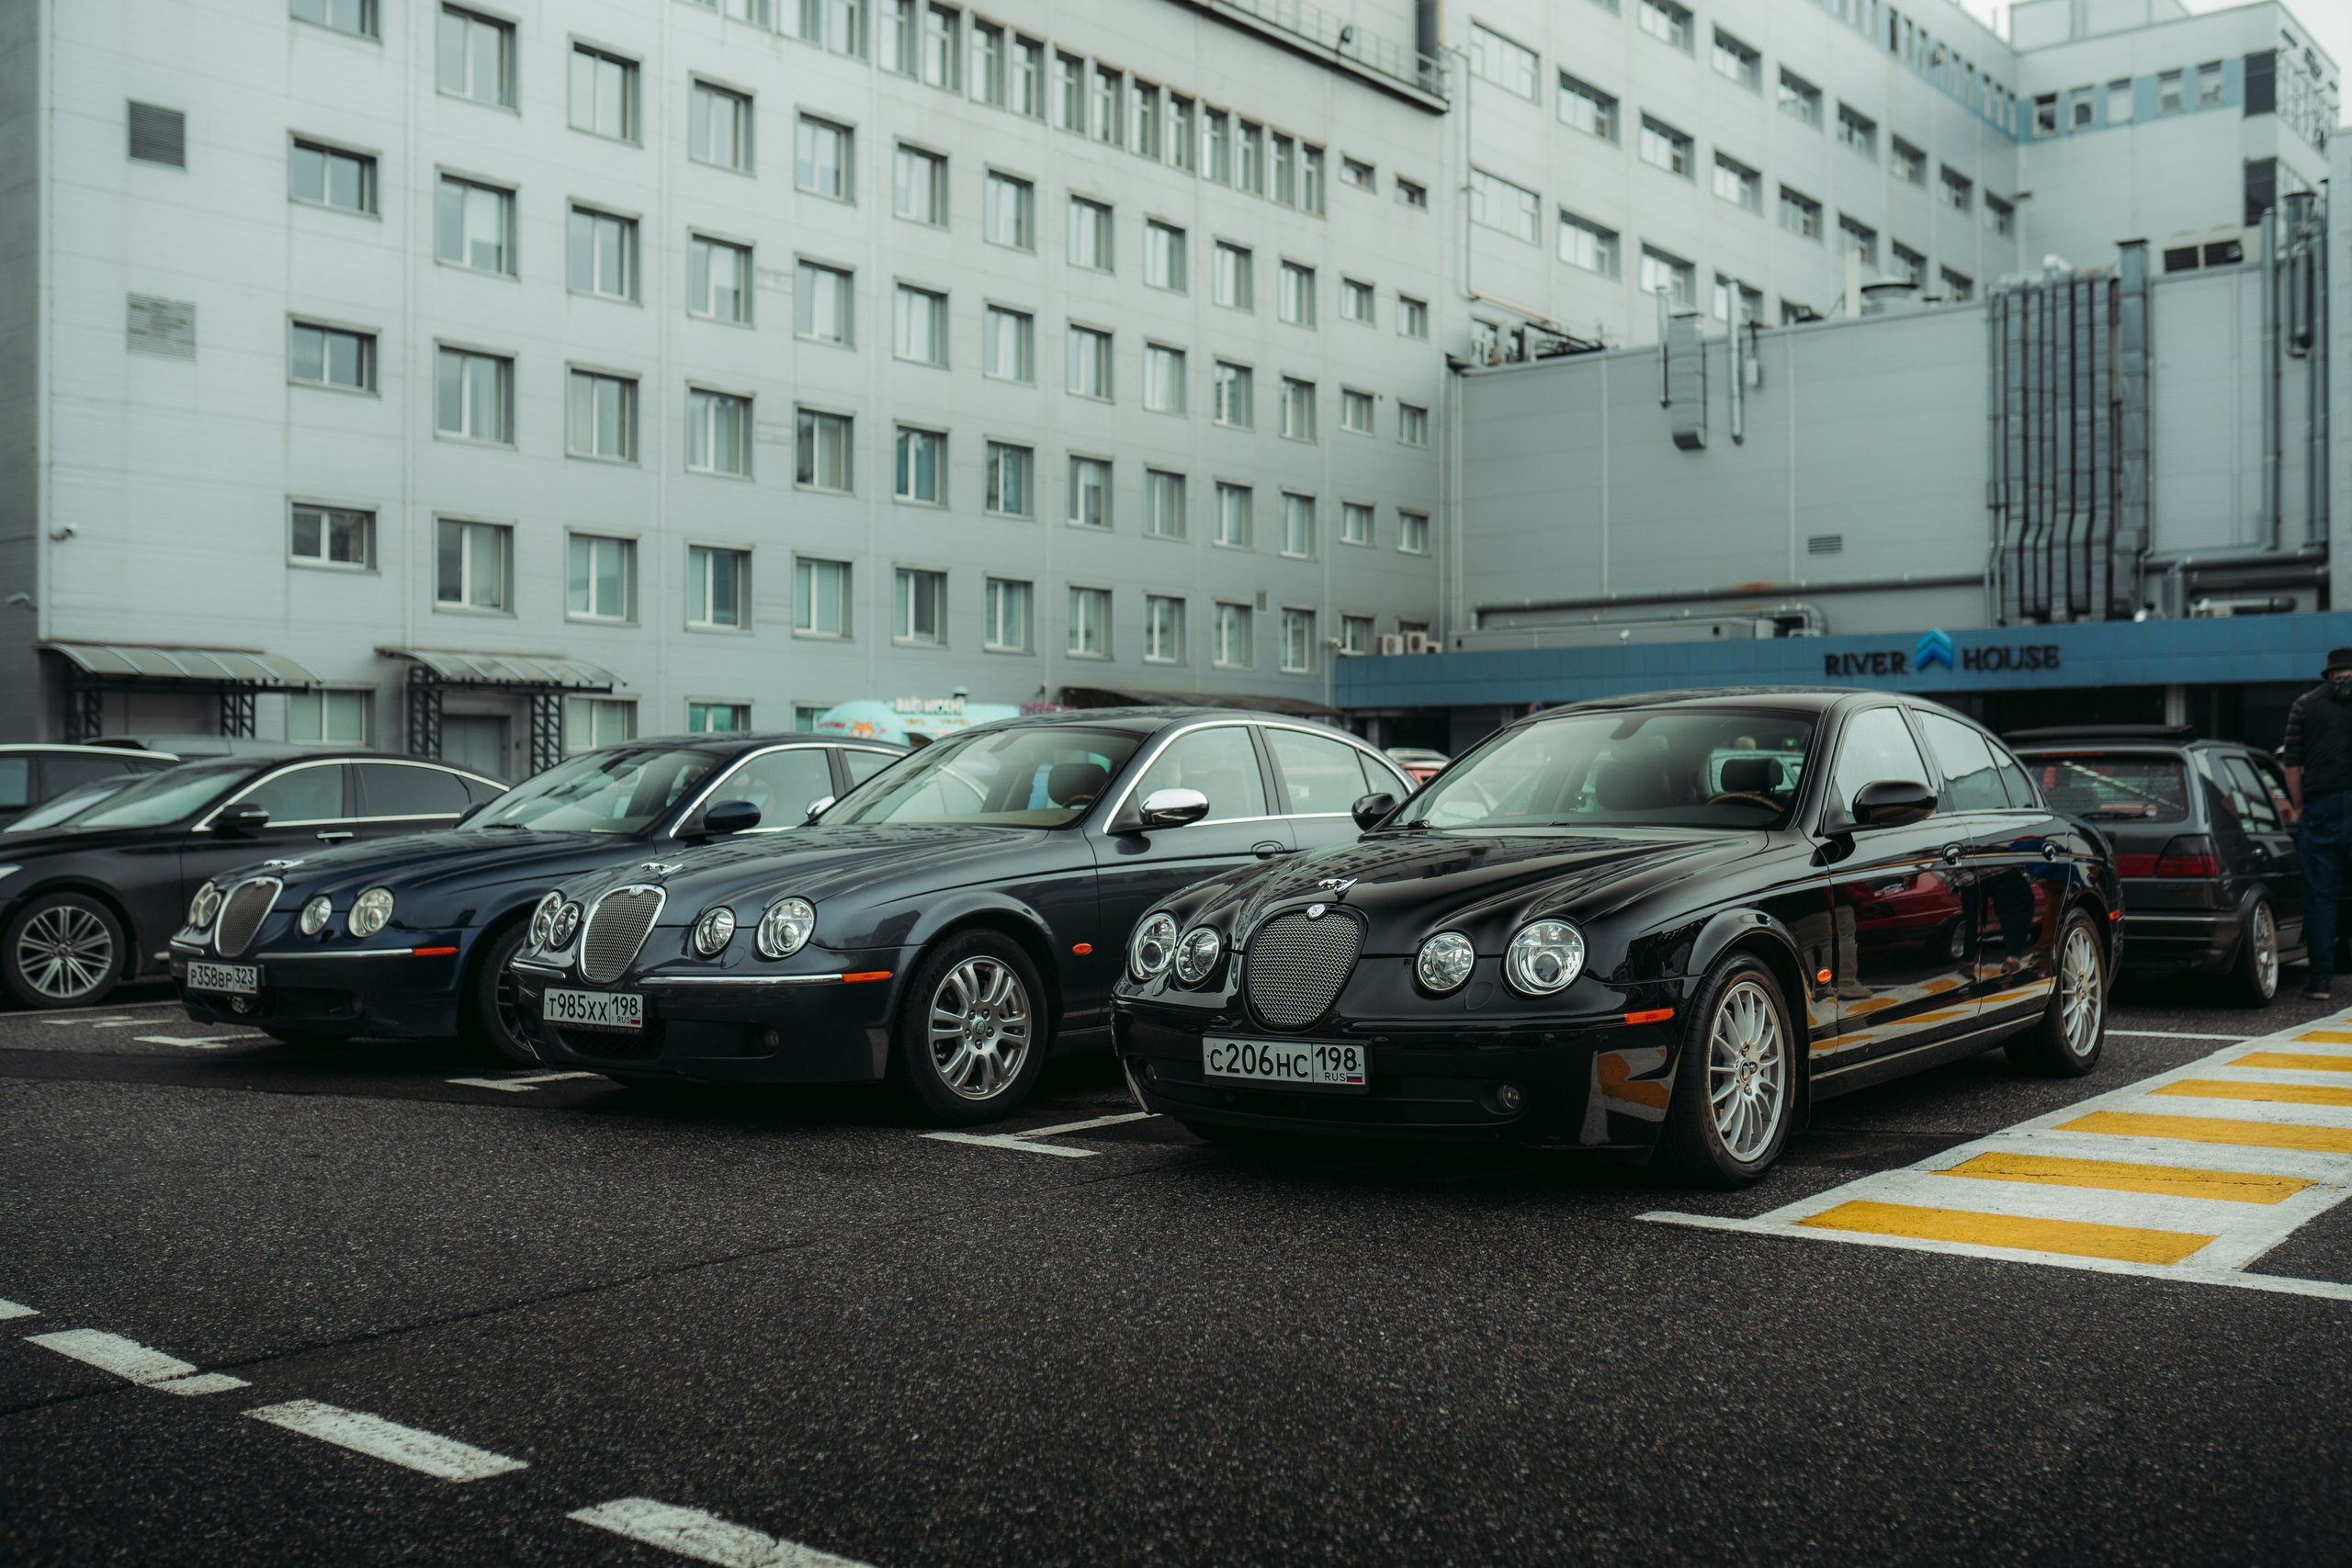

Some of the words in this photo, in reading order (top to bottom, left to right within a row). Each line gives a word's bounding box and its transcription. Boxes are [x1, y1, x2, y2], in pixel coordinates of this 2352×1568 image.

[1824, 650, 1907, 676] RIVER
[1962, 645, 2060, 671] HOUSE
[234, 967, 254, 985] 323
[612, 996, 638, 1016] 198
[616, 1016, 630, 1024] RUS
[1315, 1046, 1357, 1072] 198
[1324, 1072, 1346, 1082] RUS
